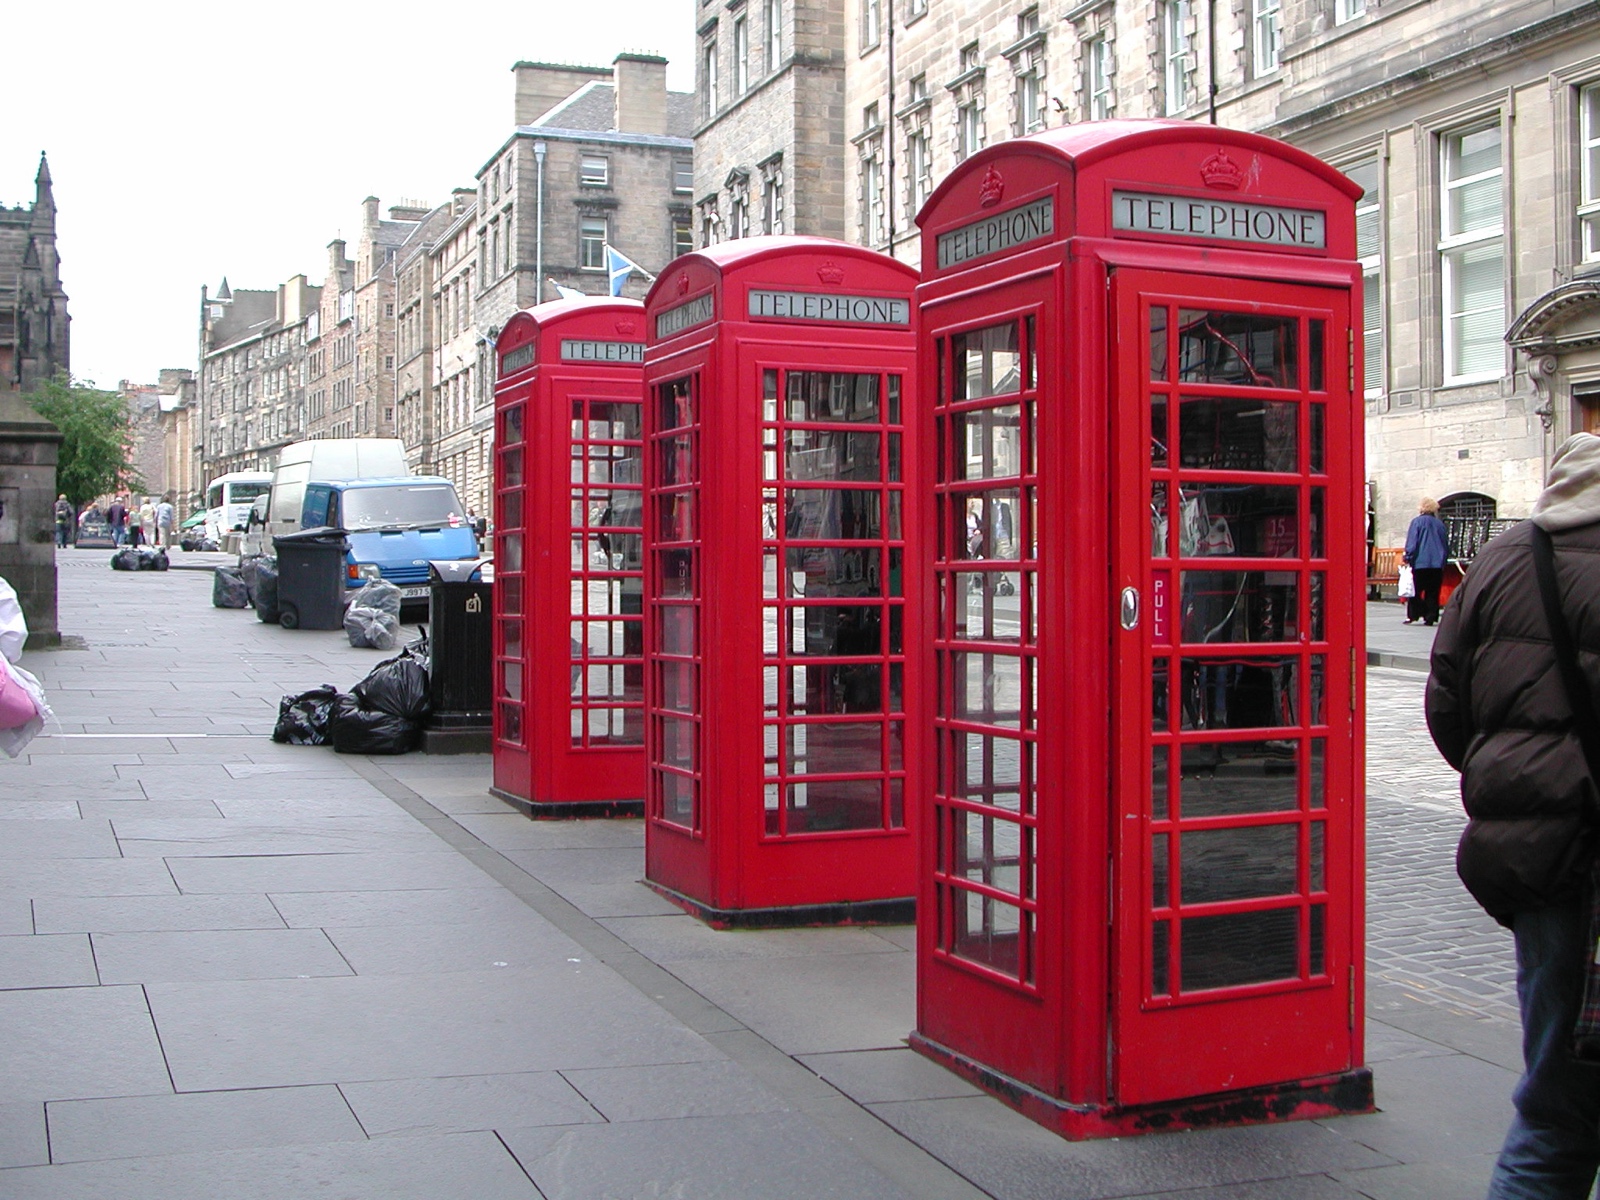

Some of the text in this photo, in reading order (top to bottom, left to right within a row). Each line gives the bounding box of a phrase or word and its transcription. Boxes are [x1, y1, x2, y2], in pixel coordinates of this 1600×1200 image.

[940, 202, 1053, 267] TELEPHONE
[1121, 196, 1316, 245] TELEPHONE
[659, 295, 713, 336] TELEPHONE
[754, 292, 903, 324] TELEPHONE
[566, 341, 643, 361] TELEPH
[1270, 518, 1285, 537] 15
[1154, 580, 1164, 637] PULL
